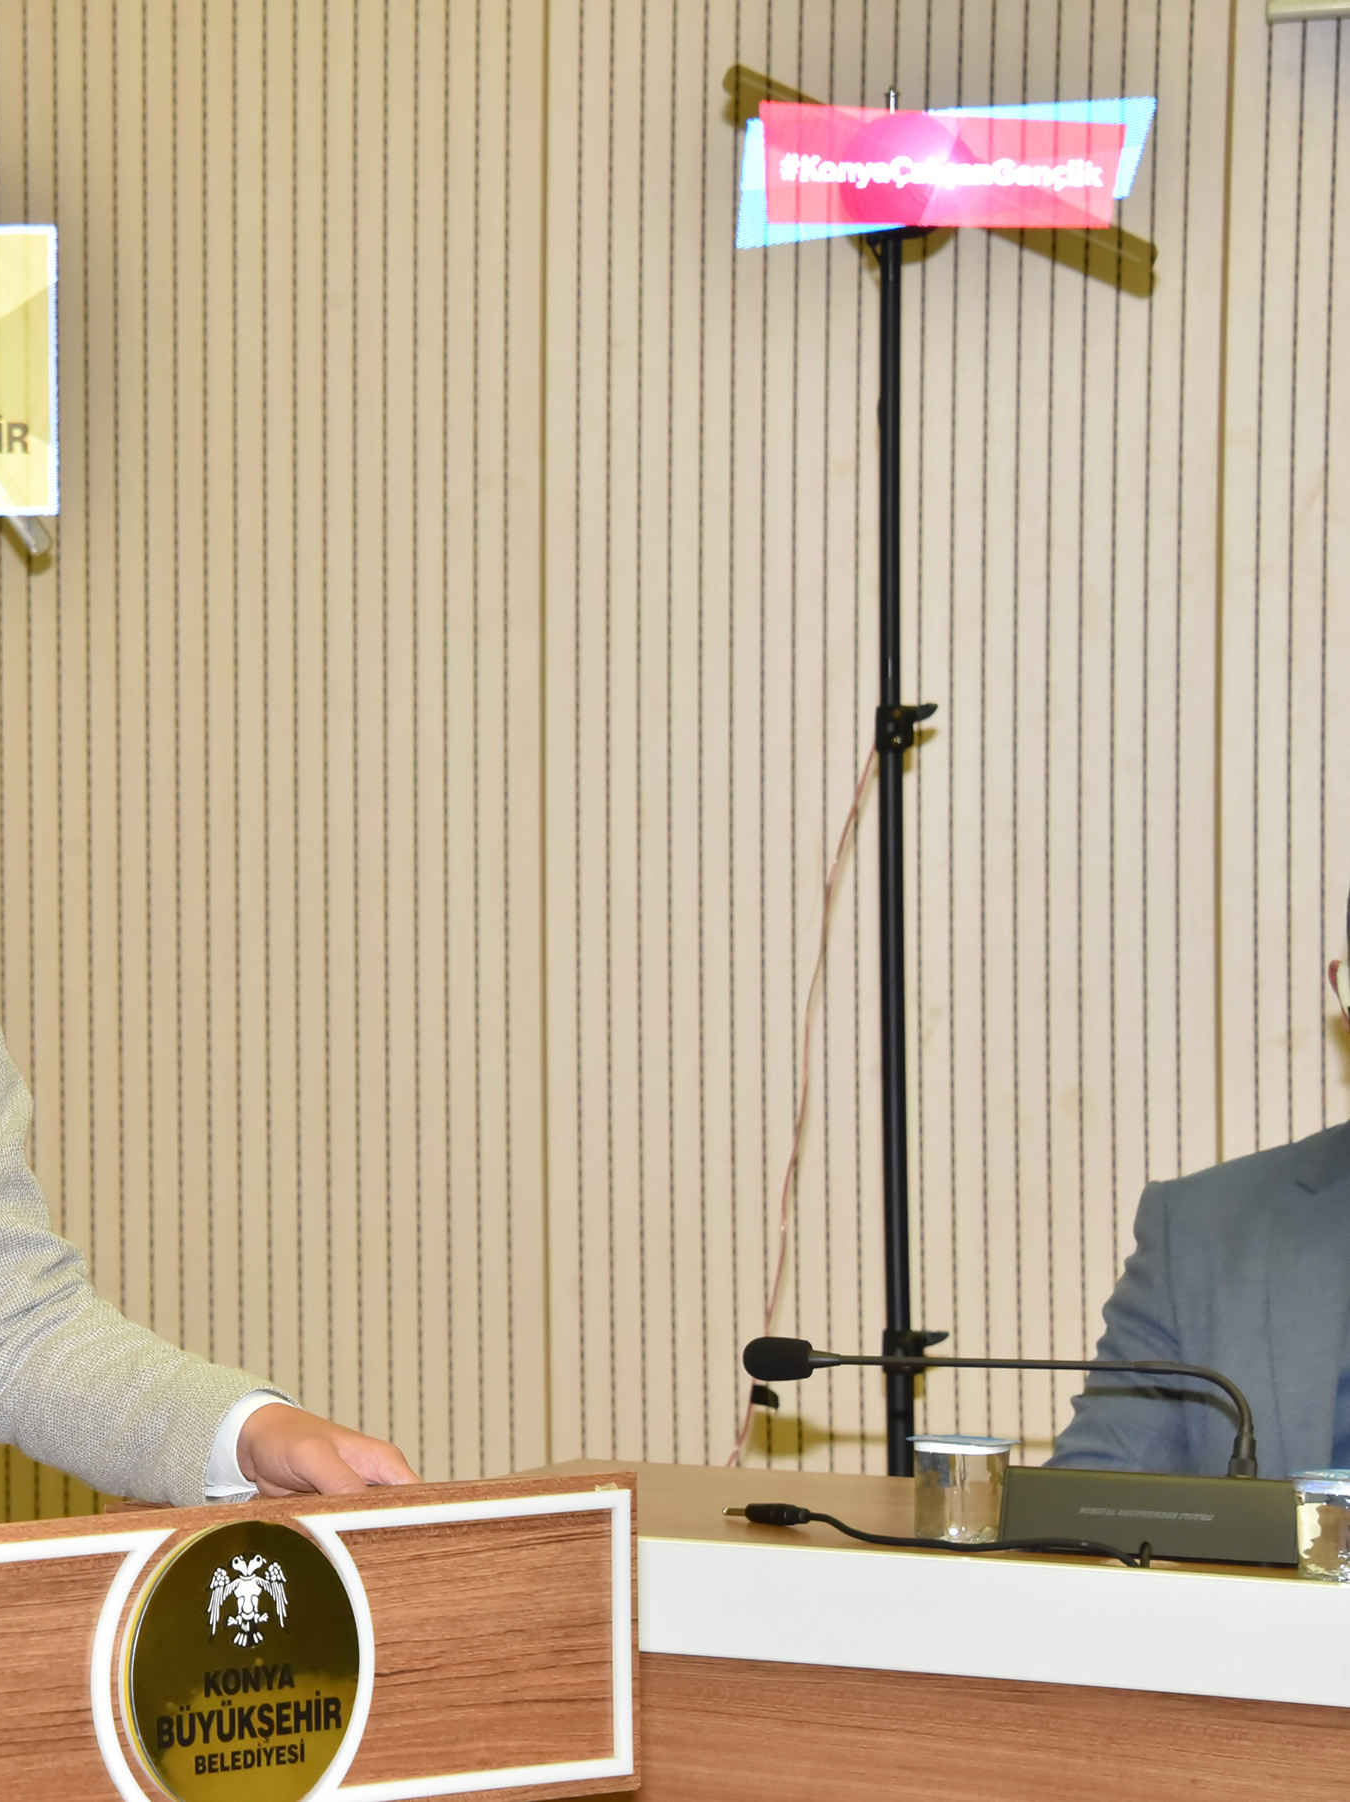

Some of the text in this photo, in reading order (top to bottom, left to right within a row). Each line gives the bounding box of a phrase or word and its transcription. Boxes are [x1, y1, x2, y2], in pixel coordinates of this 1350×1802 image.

[203, 1663, 296, 1698] KONYA
[155, 1690, 342, 1750] BÜYÜKŞEHİR
[194, 1739, 306, 1775] BELEDİYESİ
